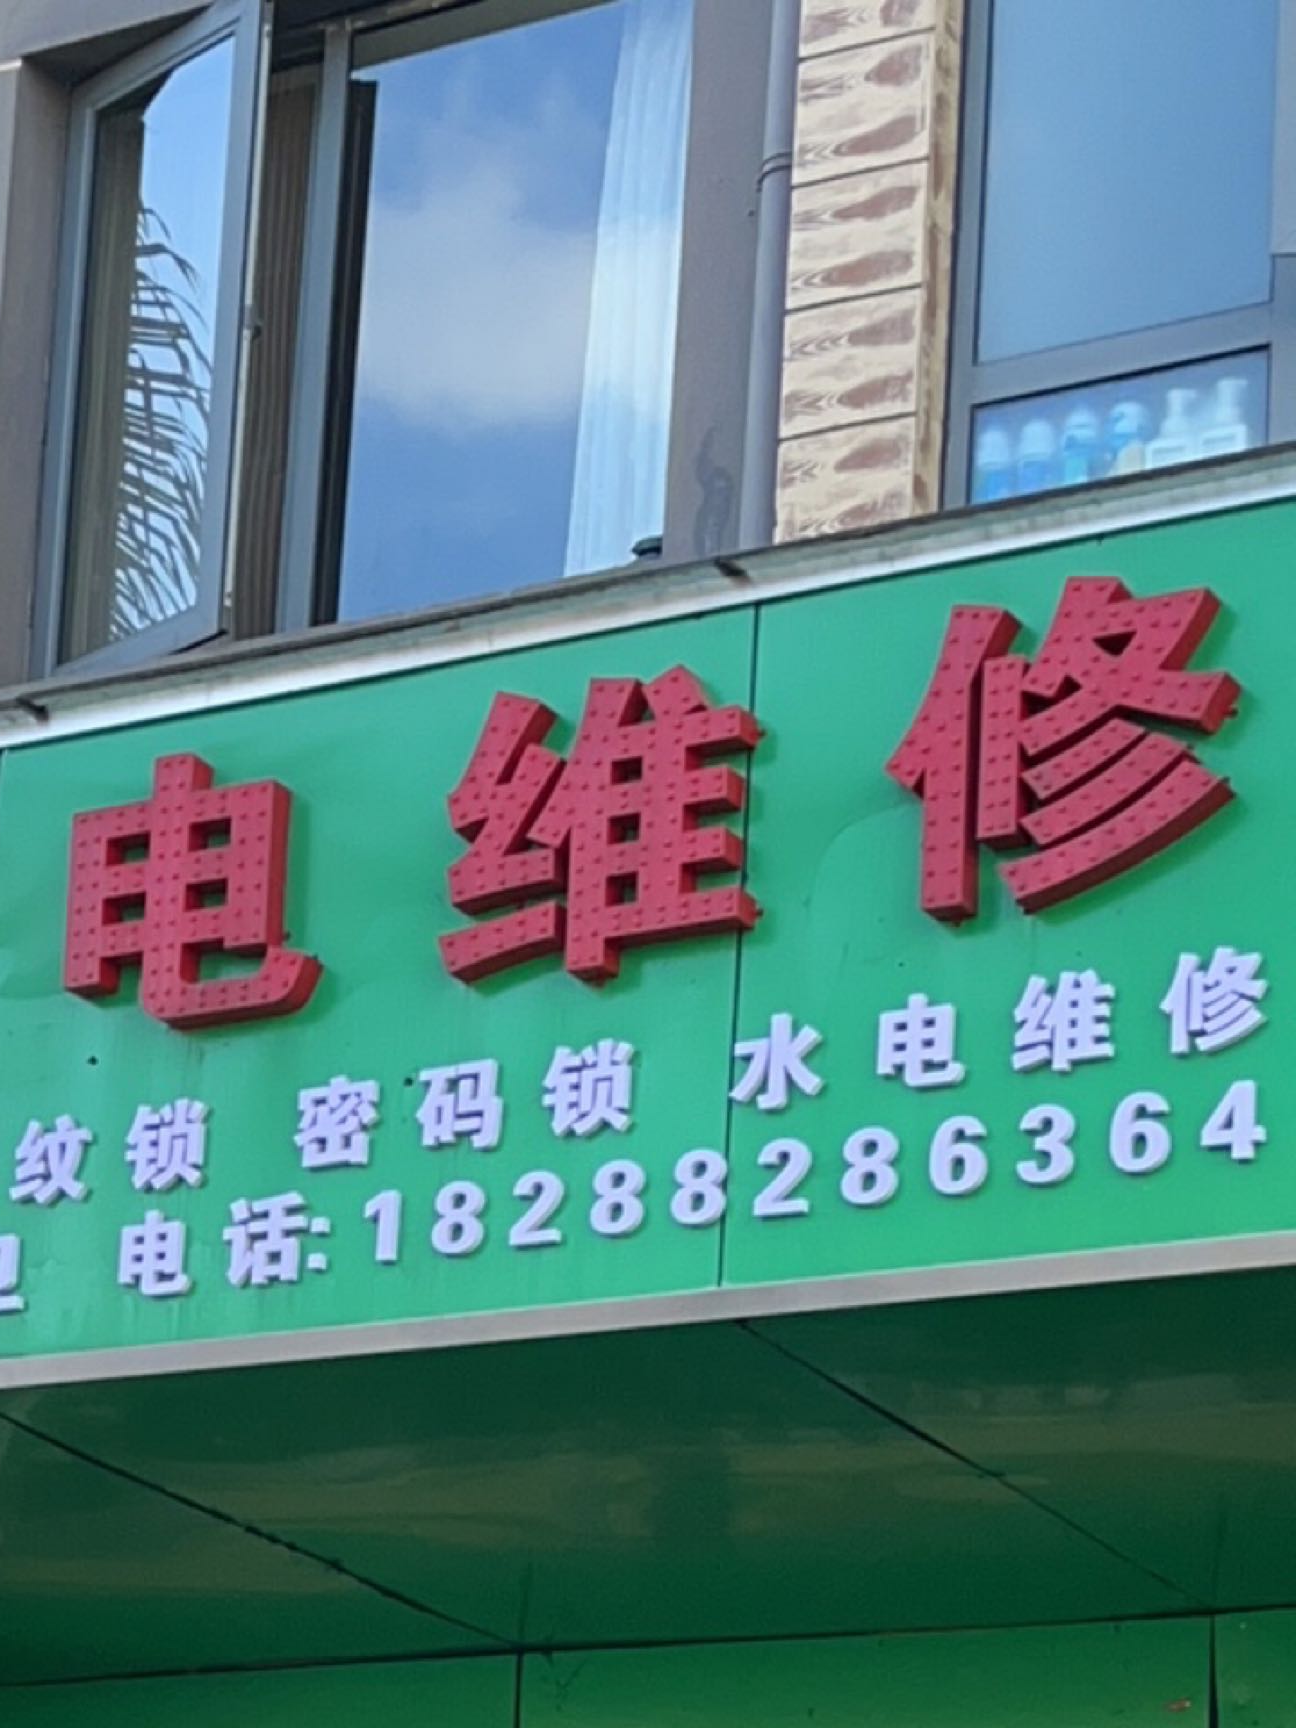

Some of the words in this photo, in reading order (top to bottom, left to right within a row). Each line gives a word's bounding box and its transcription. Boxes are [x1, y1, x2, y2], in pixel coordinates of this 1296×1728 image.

[295, 1036, 634, 1170] 密码锁
[730, 947, 1268, 1111] 水电维修
